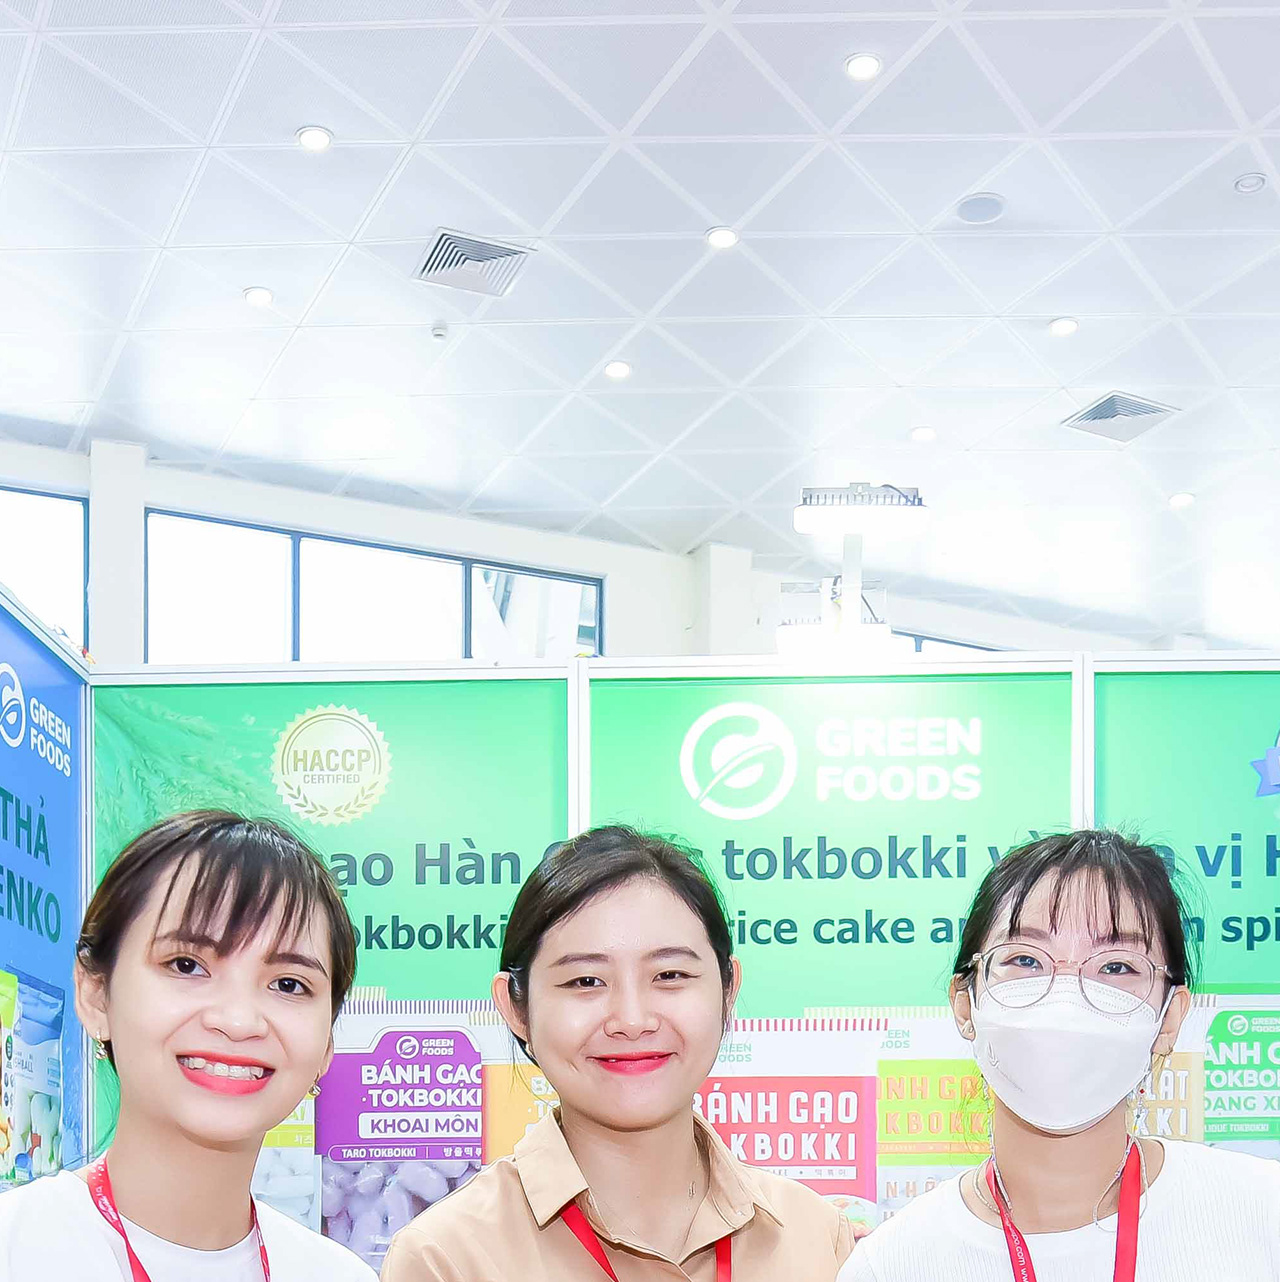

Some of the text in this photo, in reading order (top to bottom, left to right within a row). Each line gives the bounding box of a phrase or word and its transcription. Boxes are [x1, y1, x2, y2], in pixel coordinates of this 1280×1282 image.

[29, 696, 72, 750] GREEN
[816, 717, 983, 757] GREEN
[29, 726, 72, 778] FOODS
[292, 749, 372, 772] HACCP
[302, 774, 361, 785] CERTIFIED
[816, 765, 982, 801] FOODS
[414, 837, 521, 886] Hàn
[722, 834, 967, 880] tokbokki
[1195, 832, 1242, 889] vị
[813, 909, 915, 944] cake
[1251, 1017, 1280, 1025] GREEN
[1251, 1025, 1280, 1033] FOODS
[422, 1038, 454, 1047] GREEN
[422, 1047, 454, 1056] FOODS
[361, 1059, 431, 1085] BÁNH
[368, 1088, 482, 1107] TOKBOKKI
[877, 1076, 929, 1100] NH
[788, 1091, 858, 1130] GẠO
[370, 1114, 478, 1134] KHOAI MÔN
[341, 1147, 417, 1158] TARO TOKBOKKI
